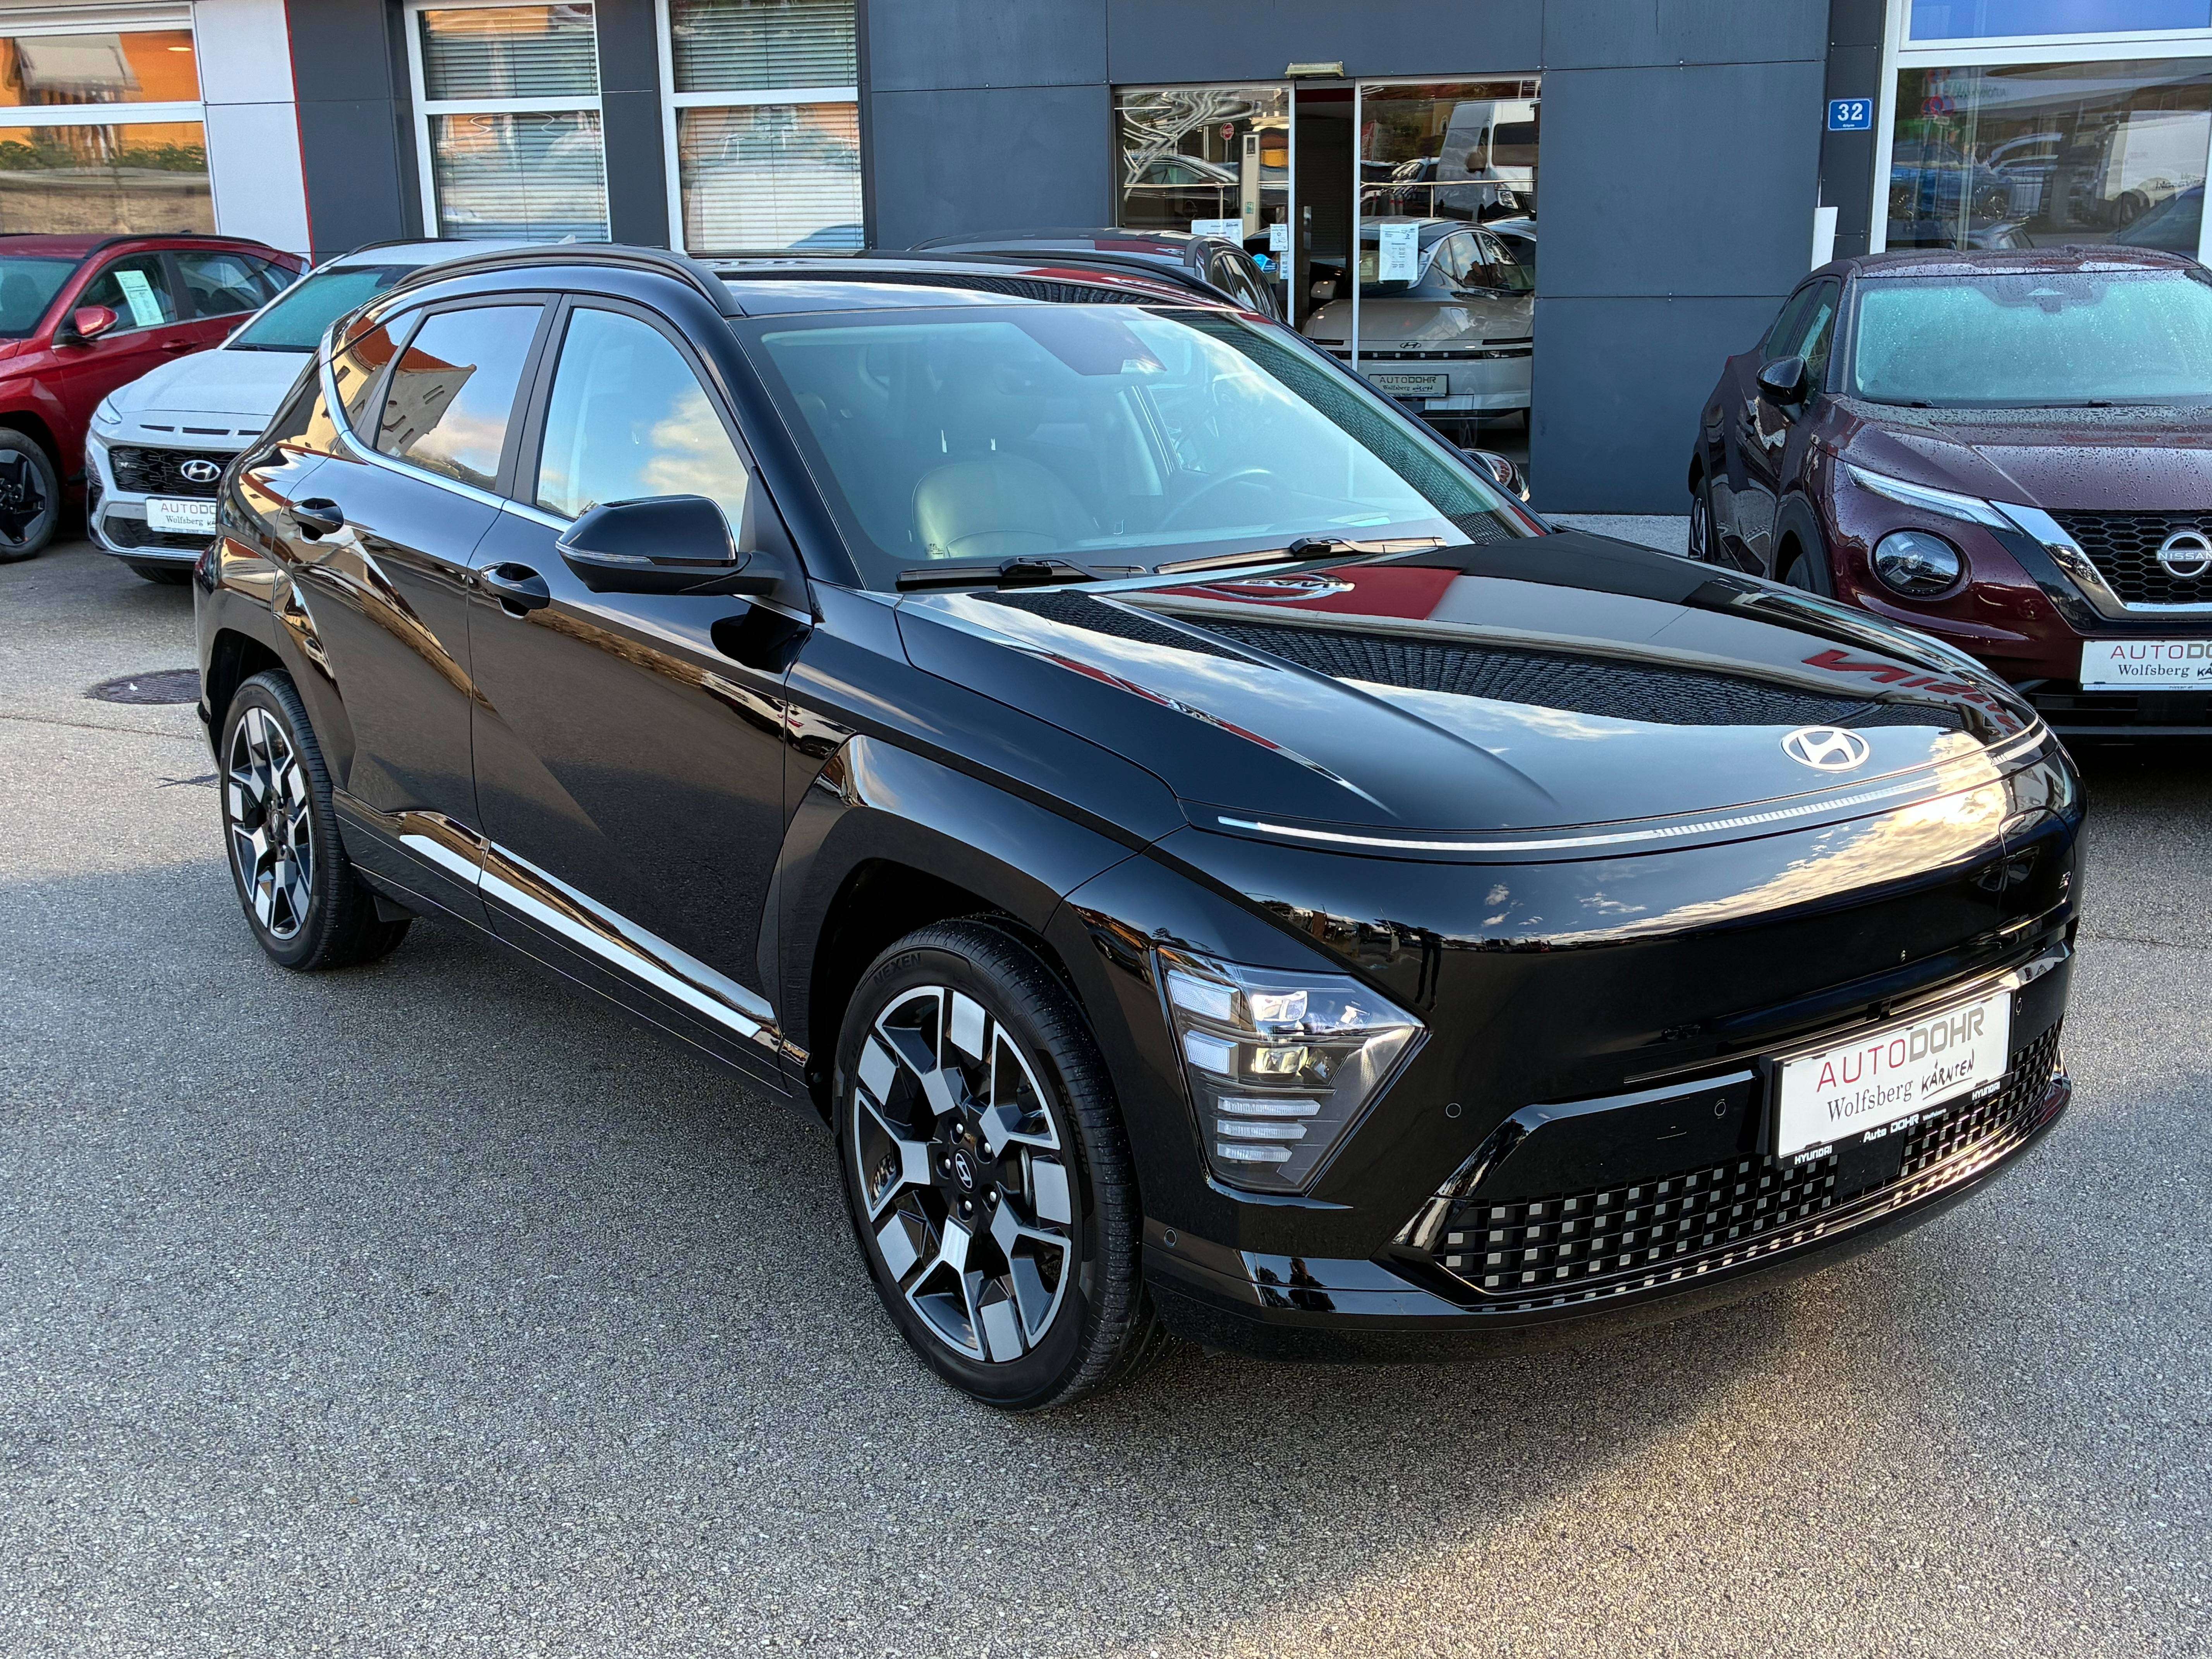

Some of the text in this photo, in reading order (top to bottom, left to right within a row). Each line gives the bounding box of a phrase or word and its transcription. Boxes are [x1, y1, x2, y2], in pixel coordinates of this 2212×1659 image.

[1837, 103, 1863, 121] 32
[2158, 550, 2212, 560] NISSAN
[2118, 664, 2190, 678] Wolfsberg
[873, 952, 921, 985] NEXEN
[1816, 1006, 1984, 1092] AUTODOHR
[1827, 1080, 1913, 1122] Wolfsberg
[1794, 1145, 1832, 1165] HYUNDAI
[1863, 1128, 1887, 1143] Auto
[1890, 1113, 1919, 1133] DOHR
[1972, 1081, 2001, 1101] HYUNDAI
